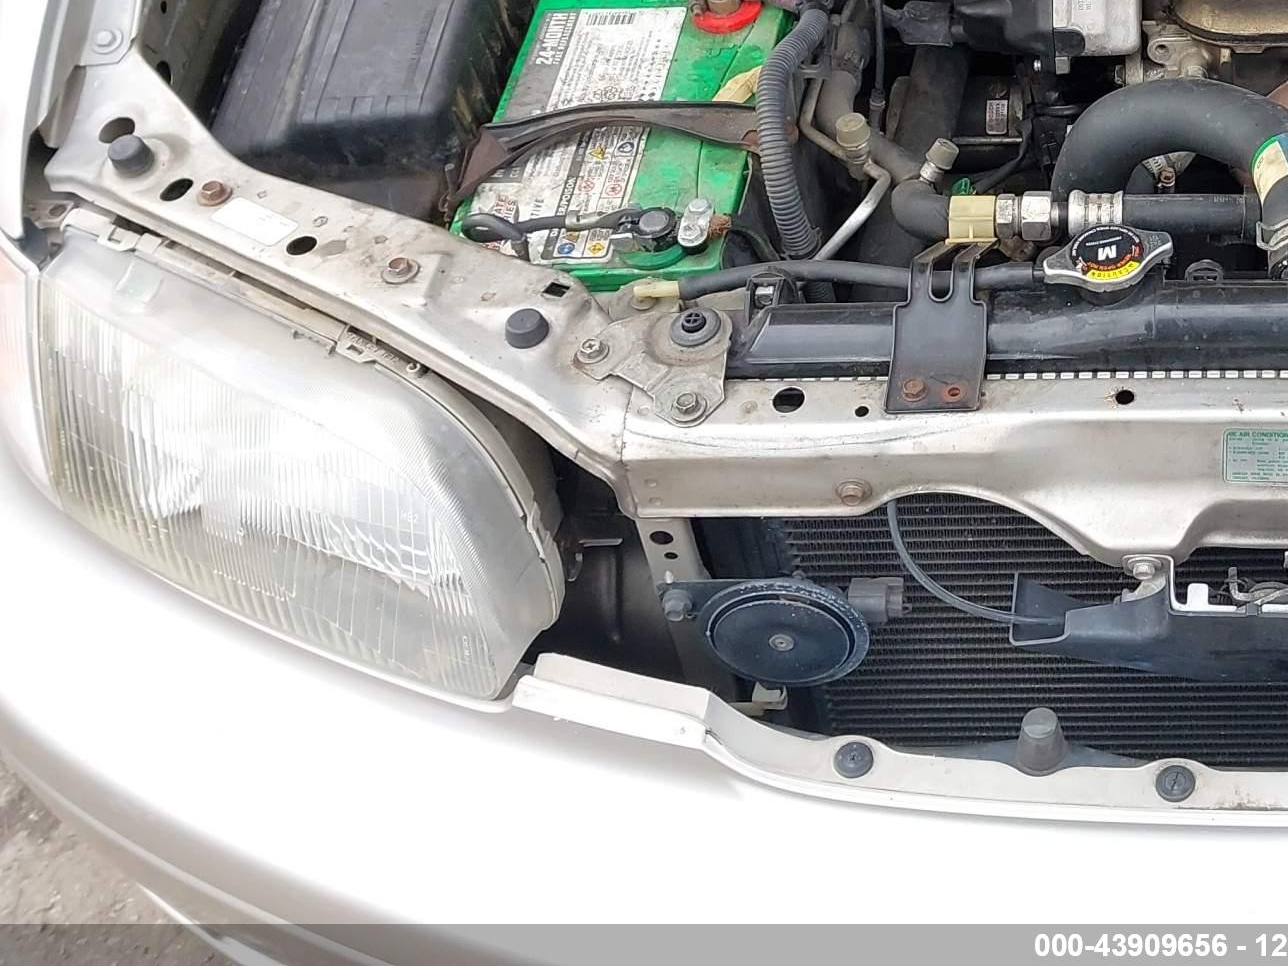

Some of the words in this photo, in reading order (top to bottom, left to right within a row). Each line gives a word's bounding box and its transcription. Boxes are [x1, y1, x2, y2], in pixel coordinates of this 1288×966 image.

[535, 11, 570, 65] 24-MONTH
[549, 177, 577, 239] DER/POISON
[1097, 244, 1117, 261] M
[1091, 267, 1129, 279] CAUTION
